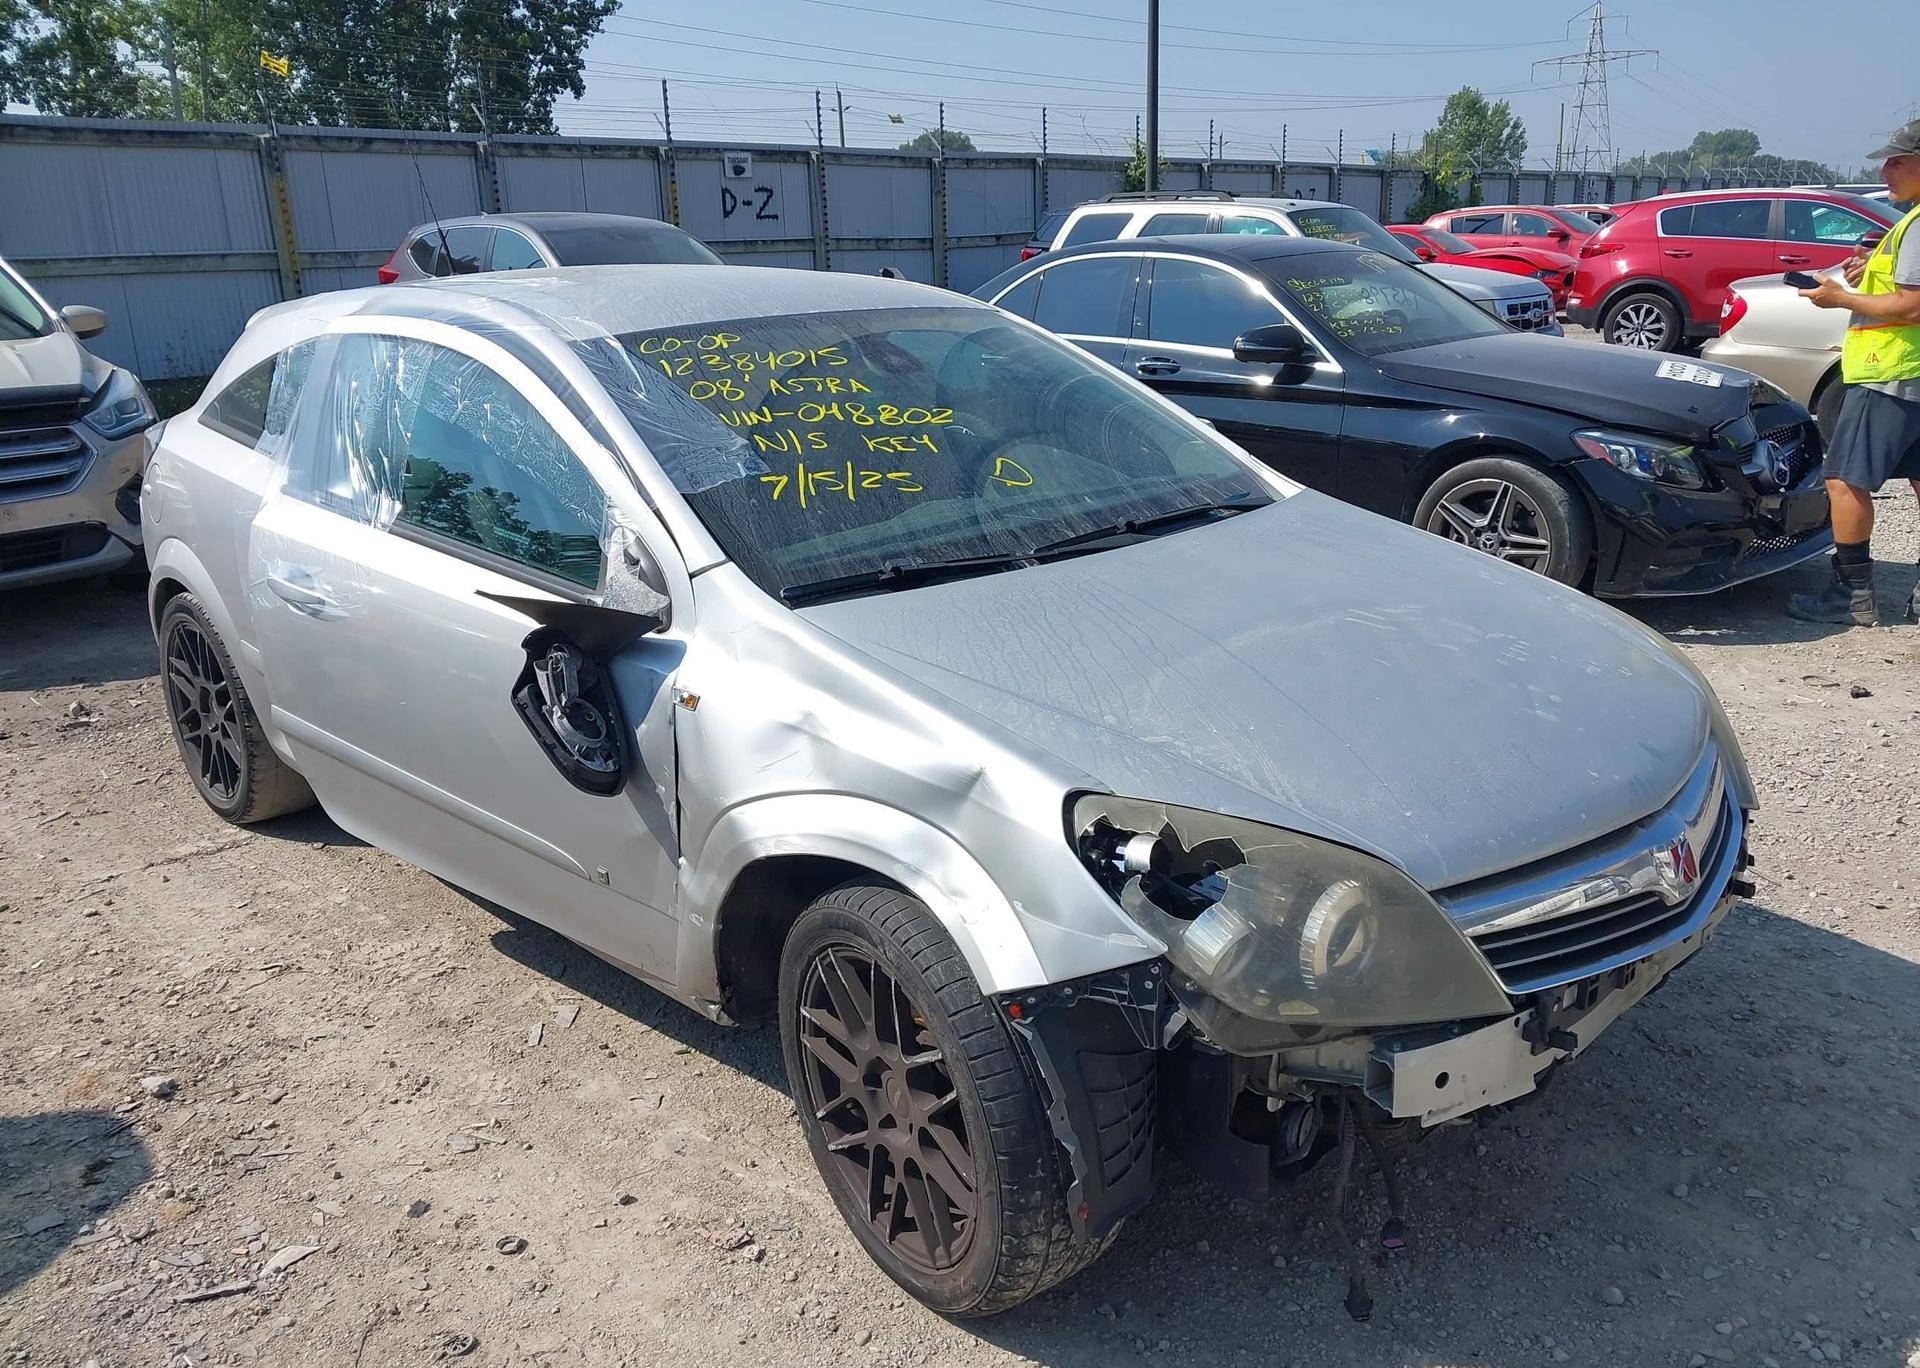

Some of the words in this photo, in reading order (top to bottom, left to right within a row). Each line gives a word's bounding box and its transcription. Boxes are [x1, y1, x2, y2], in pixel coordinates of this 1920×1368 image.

[639, 332, 741, 354] CO-OP
[659, 347, 849, 379] 12384015
[769, 377, 872, 396] ASTRA
[719, 402, 954, 427] VIN-048802
[753, 428, 829, 455] N/S
[861, 433, 939, 454] KEY
[759, 460, 924, 509] 7/15/25
